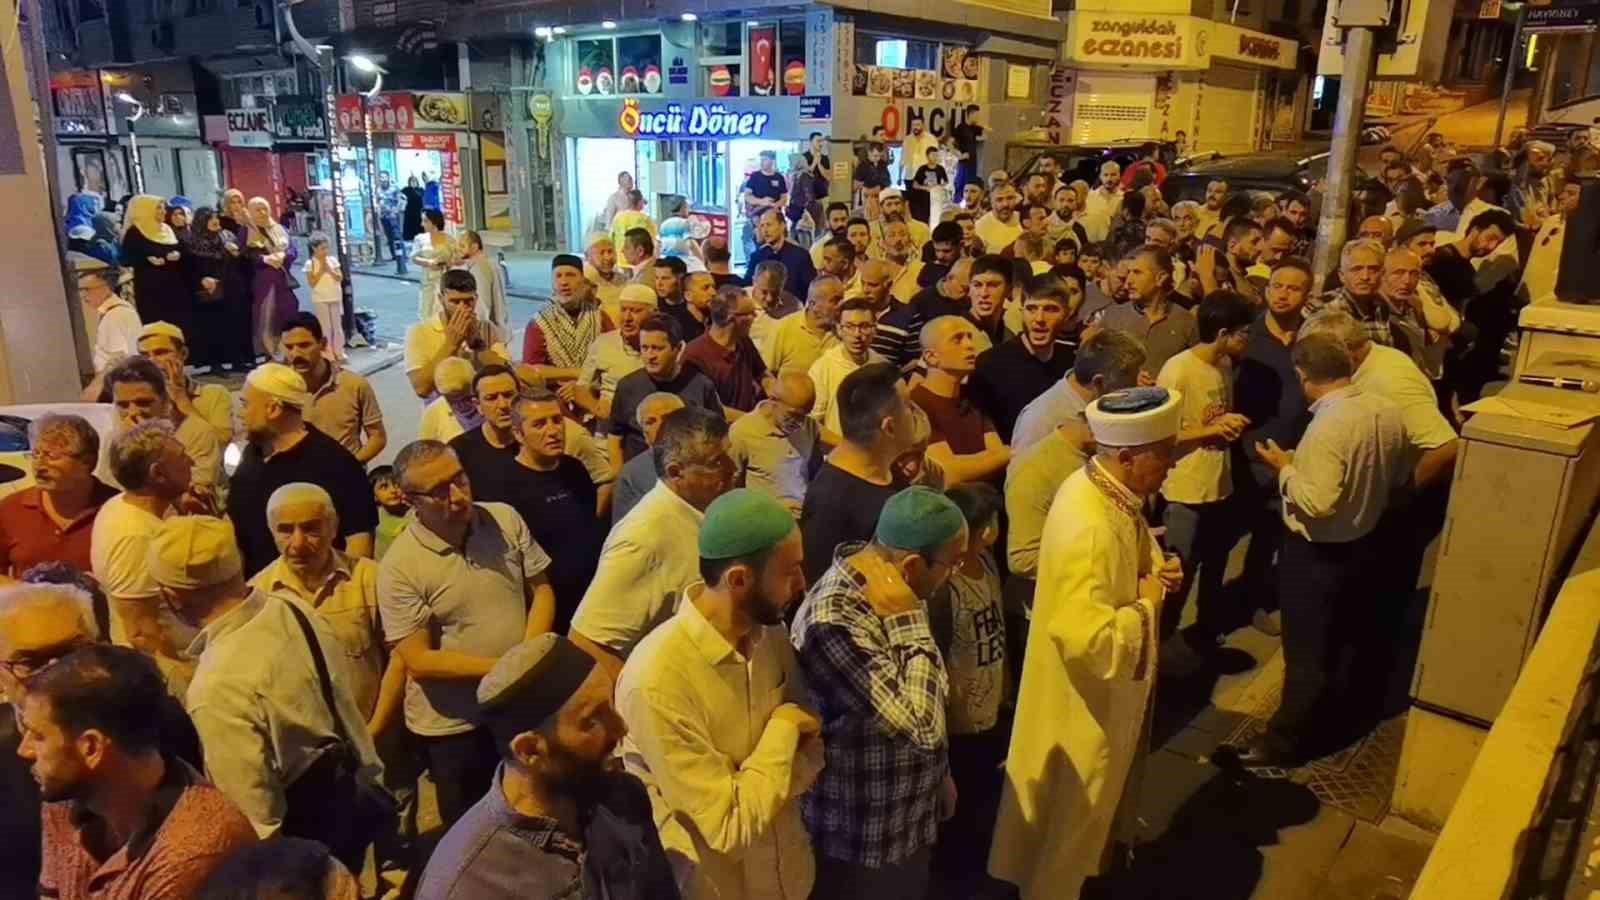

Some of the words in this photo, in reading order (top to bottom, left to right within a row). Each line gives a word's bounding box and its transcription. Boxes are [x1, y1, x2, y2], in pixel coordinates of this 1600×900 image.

[1091, 19, 1176, 37] zonguldak
[1082, 36, 1182, 58] eczanesi
[619, 97, 682, 135] Öncü
[688, 104, 768, 135] Döner
[1048, 69, 1064, 144] ECZAN
[227, 111, 268, 132] ECZANE
